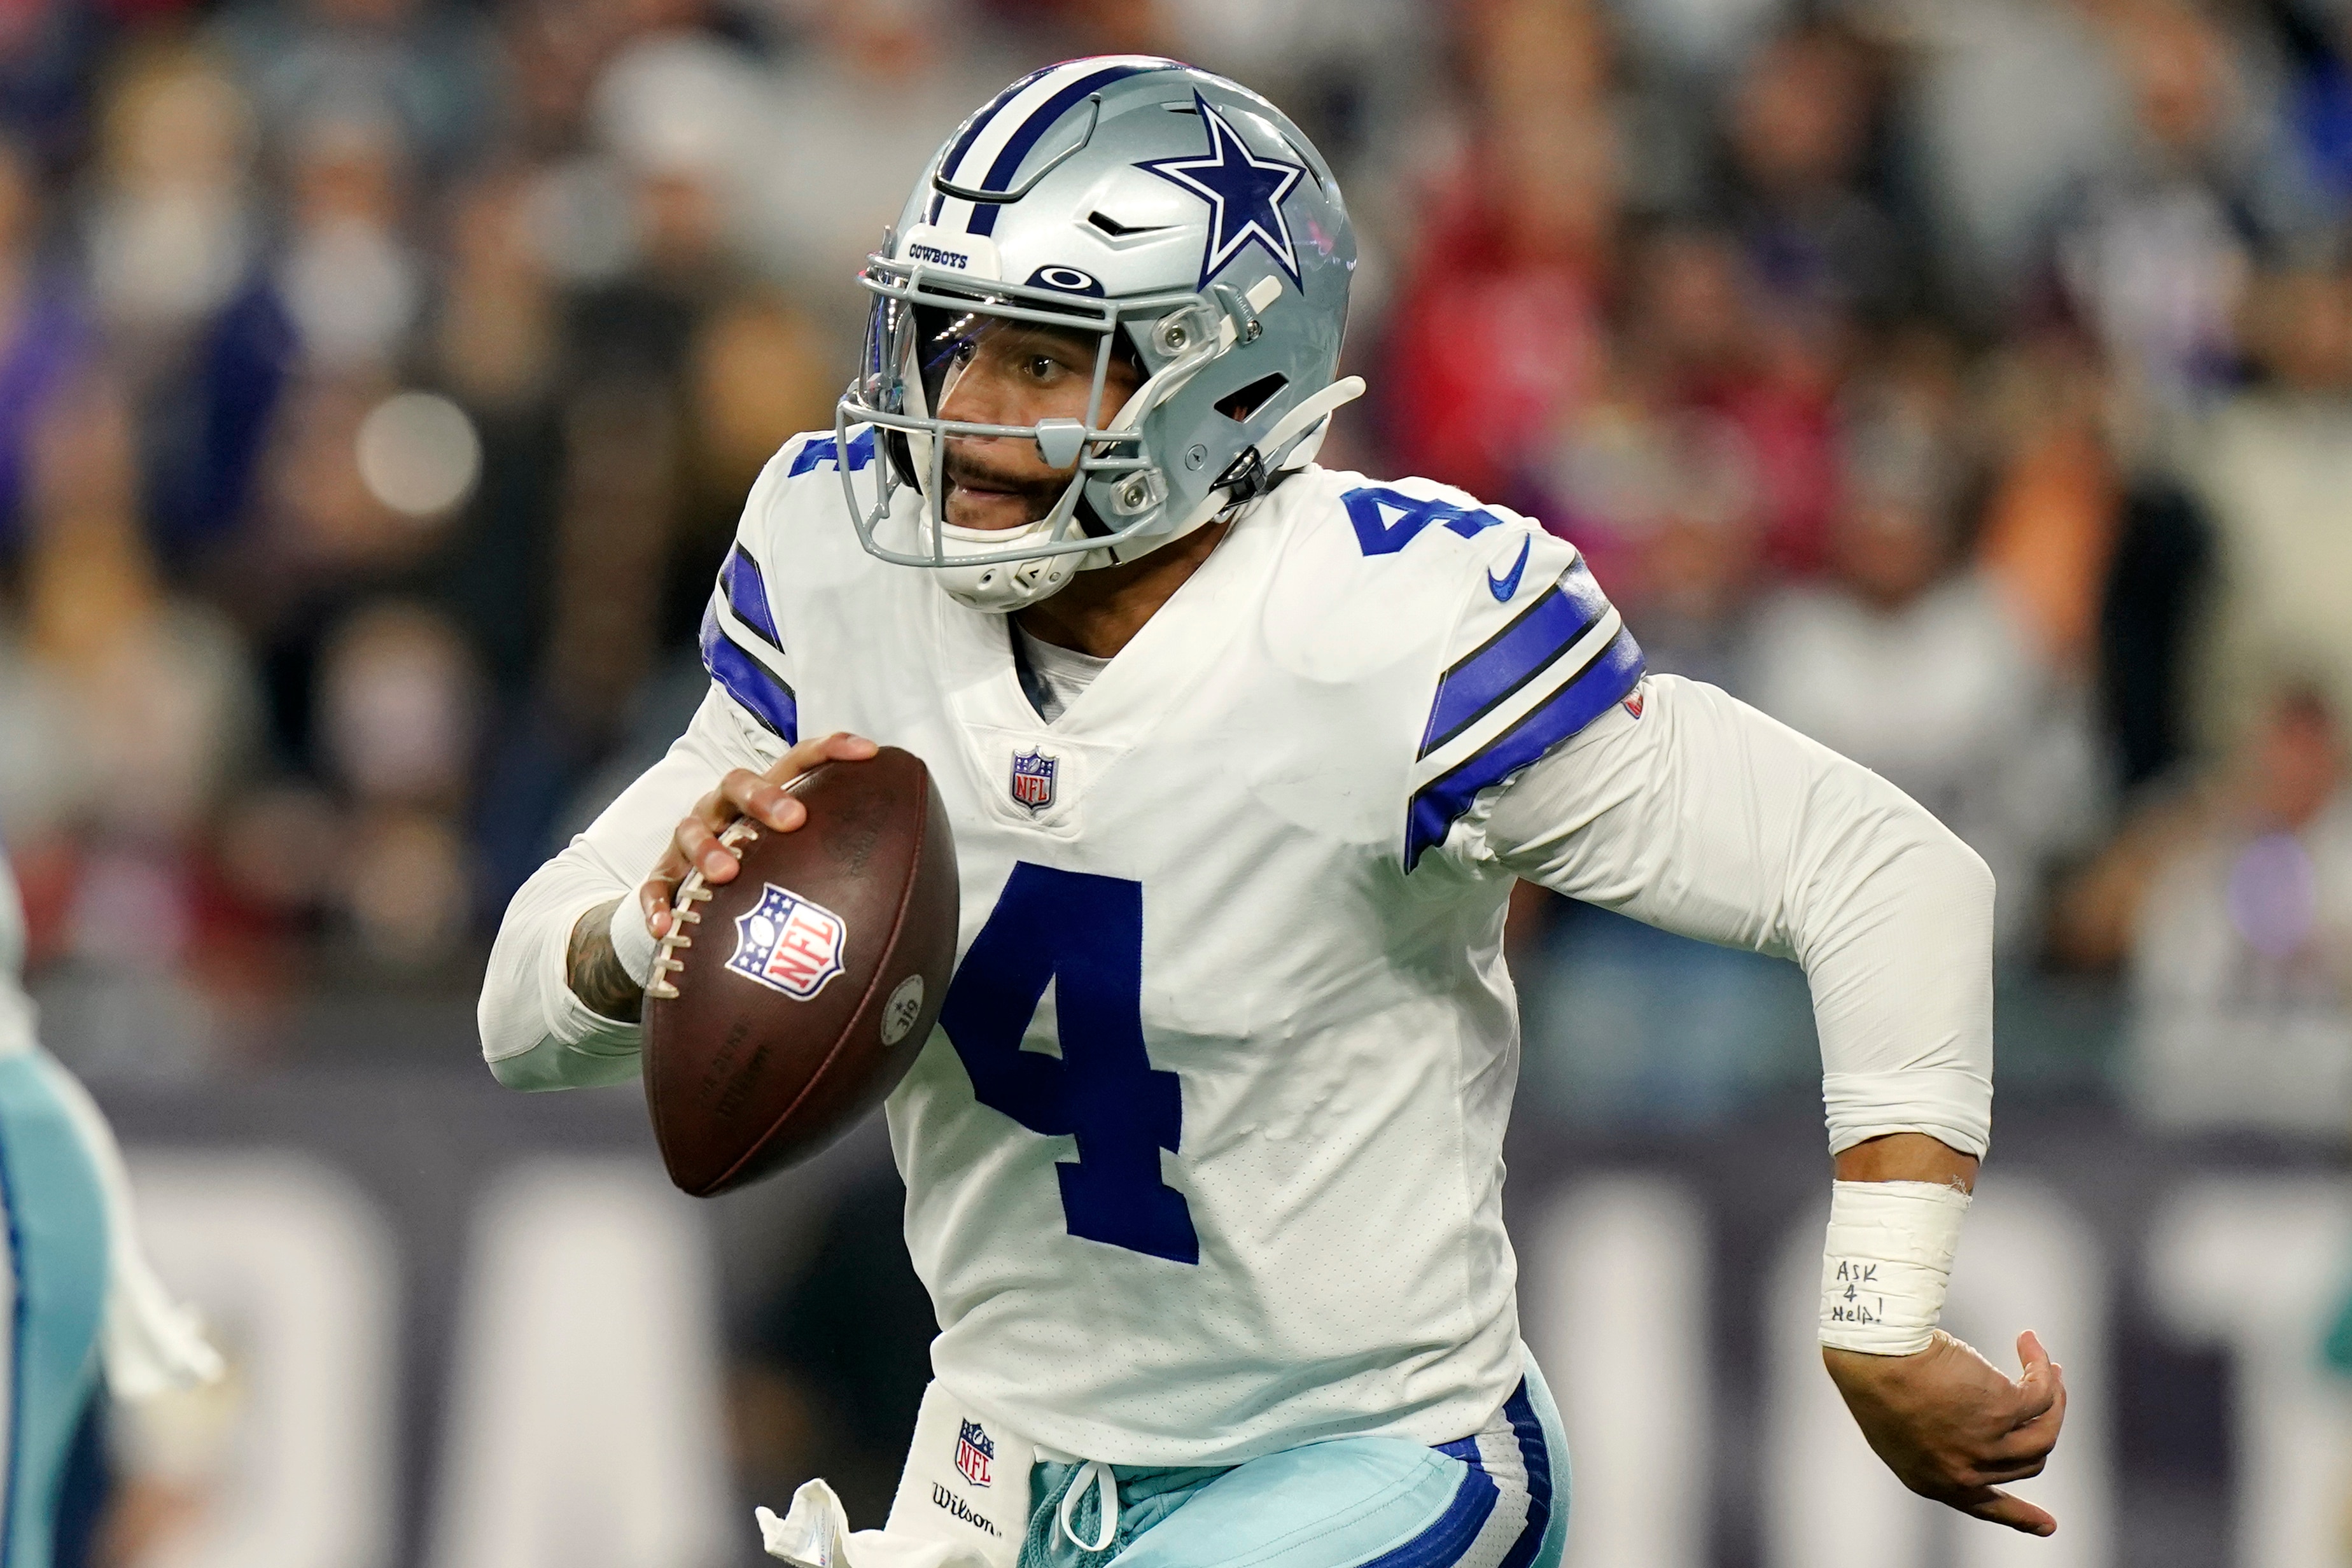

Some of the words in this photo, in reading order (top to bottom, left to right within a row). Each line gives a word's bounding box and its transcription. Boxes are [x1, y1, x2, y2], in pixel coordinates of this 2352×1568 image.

[909, 244, 968, 269] COWBOYS
[1340, 487, 1504, 556] 4
[1016, 775, 1047, 802] NFL
[769, 916, 834, 990] NFL
[938, 860, 1200, 1265] 4
[1837, 1261, 1878, 1282] ASK
[1843, 1284, 1858, 1302] 4
[1831, 1297, 1883, 1325] Help!
[958, 1440, 991, 1482] NFL
[932, 1481, 995, 1537] Wilson
